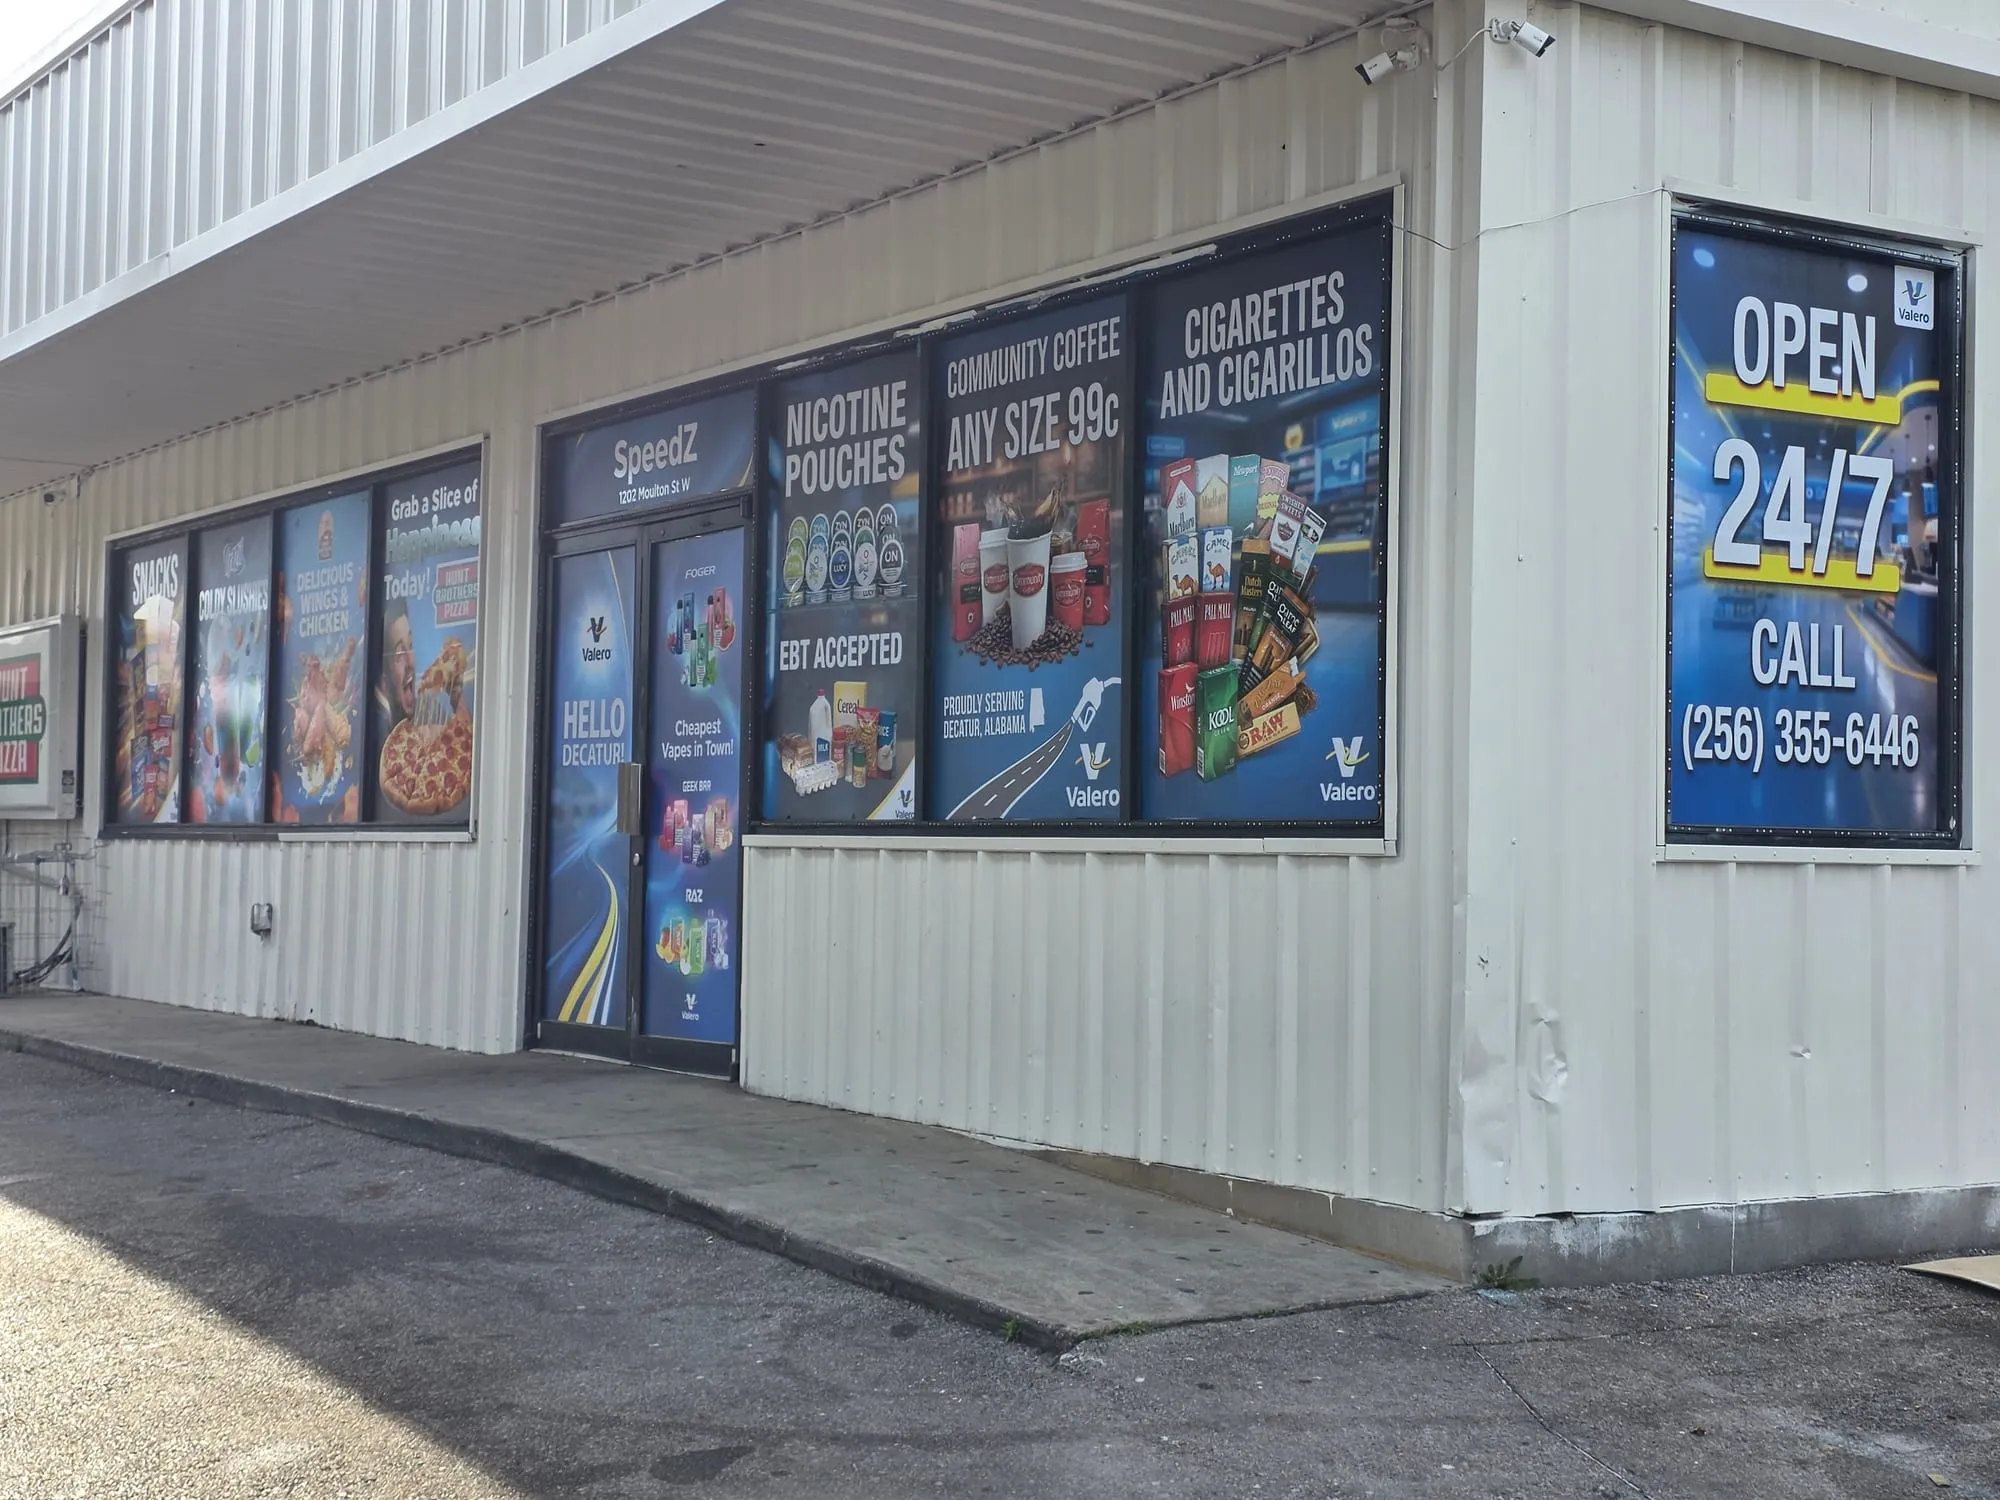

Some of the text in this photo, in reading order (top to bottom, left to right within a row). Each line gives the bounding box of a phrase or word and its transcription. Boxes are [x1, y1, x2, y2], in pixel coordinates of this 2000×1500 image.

[1185, 270, 1344, 359] CIGARETTES
[1899, 306, 1930, 324] Valero
[947, 316, 1121, 399] COMMUNITY COFFEE
[1733, 295, 1877, 400] OPEN
[1160, 323, 1373, 419] AND CIGARILLOS
[787, 380, 906, 448] NICOTINE
[947, 407, 998, 472] ANY
[1004, 391, 1061, 459] SIZE
[613, 422, 698, 485] SpeedZ
[785, 433, 905, 498] POUCHES
[1233, 464, 1258, 477] Newport
[391, 478, 479, 521] Grab a Slice of
[619, 477, 691, 505] 1202 Moulton St W
[1712, 437, 1894, 577] 24/7
[1169, 511, 1195, 535] Marlboro
[1205, 537, 1230, 552] CAMEL
[297, 562, 354, 592] DELICIOUS
[445, 567, 470, 586] HUNT
[685, 565, 716, 580] FOGER
[833, 563, 847, 573] LUCY
[384, 567, 430, 601] Today!
[300, 589, 337, 614] WINGS
[444, 601, 470, 619] PIZZA
[300, 610, 350, 638] CHICKEN
[1282, 619, 1297, 634] LEAF
[582, 647, 611, 662] Valero
[779, 632, 903, 672] EBT ACCEPTED
[1752, 618, 1856, 689] CALL
[0, 666, 28, 702] UNT
[837, 698, 860, 714] Cereal
[943, 690, 1024, 717] PROUDLY SERVING
[563, 697, 625, 739] HELLO
[675, 717, 721, 739] Cheapest
[943, 715, 1026, 739] DECATUR, ALABAMA
[1209, 706, 1235, 731] KOOL
[1249, 709, 1285, 746] RAW
[661, 739, 734, 761] Vapes in Town!
[1682, 703, 1920, 774] (256) 355-6446
[0, 739, 28, 774] IZZA
[562, 742, 625, 767] DECATUR!
[1065, 785, 1120, 808] Valero
[1320, 783, 1376, 801] Valero
